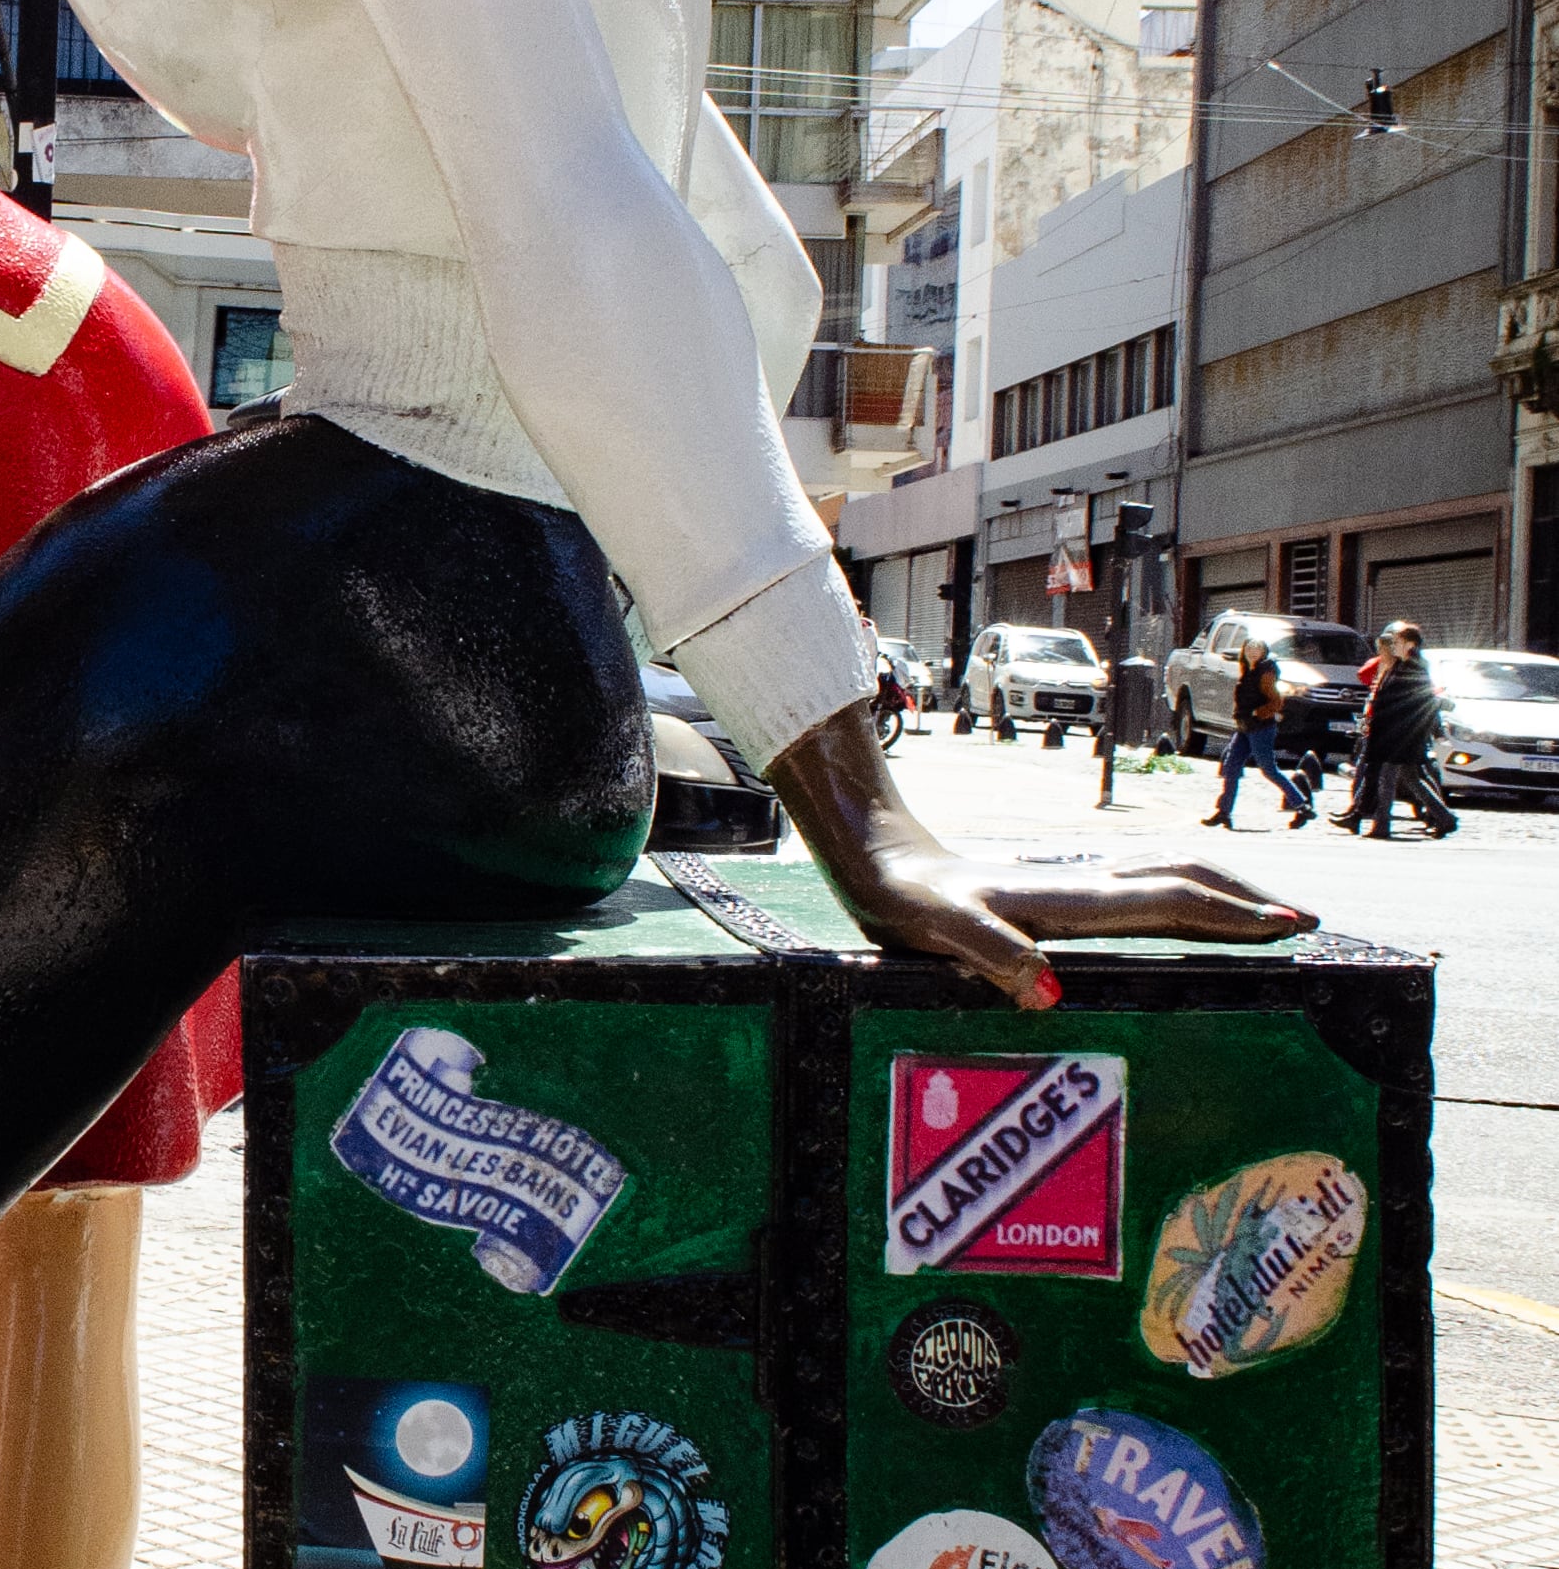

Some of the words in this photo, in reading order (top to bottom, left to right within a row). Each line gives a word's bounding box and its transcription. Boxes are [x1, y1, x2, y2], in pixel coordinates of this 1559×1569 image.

[898, 1062, 1100, 1248] CLARIDGE'S
[416, 1183, 527, 1233] SAVOIE
[997, 1224, 1100, 1247] LONDON
